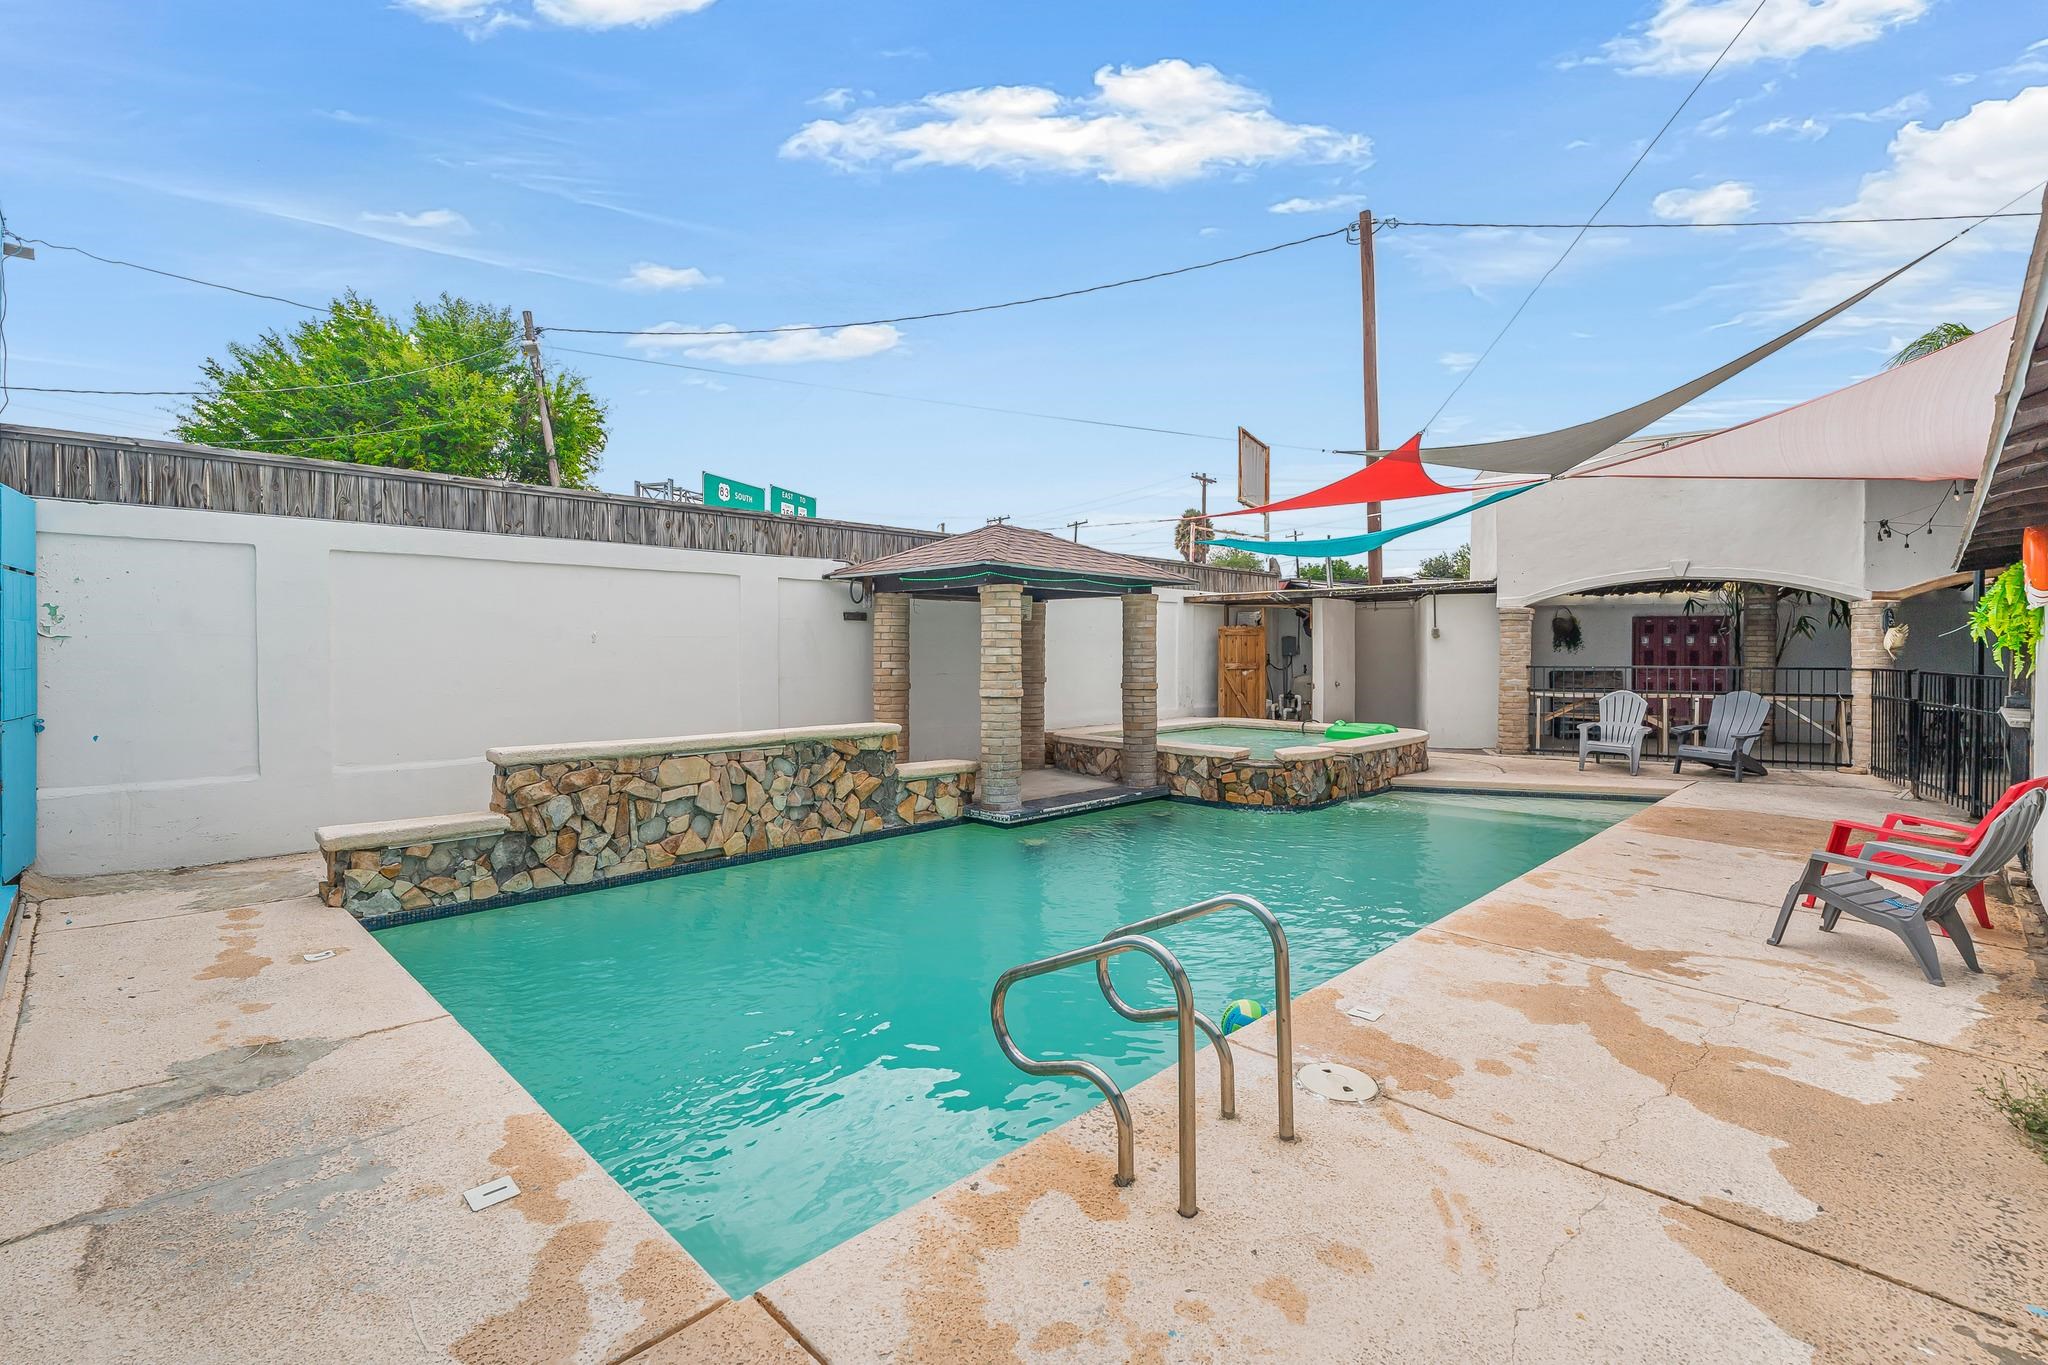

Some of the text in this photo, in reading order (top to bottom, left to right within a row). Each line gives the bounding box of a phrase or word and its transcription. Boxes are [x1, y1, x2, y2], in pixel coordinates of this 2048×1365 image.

[720, 486, 753, 503] 83 SOUTH
[781, 491, 806, 504] EAST TO
